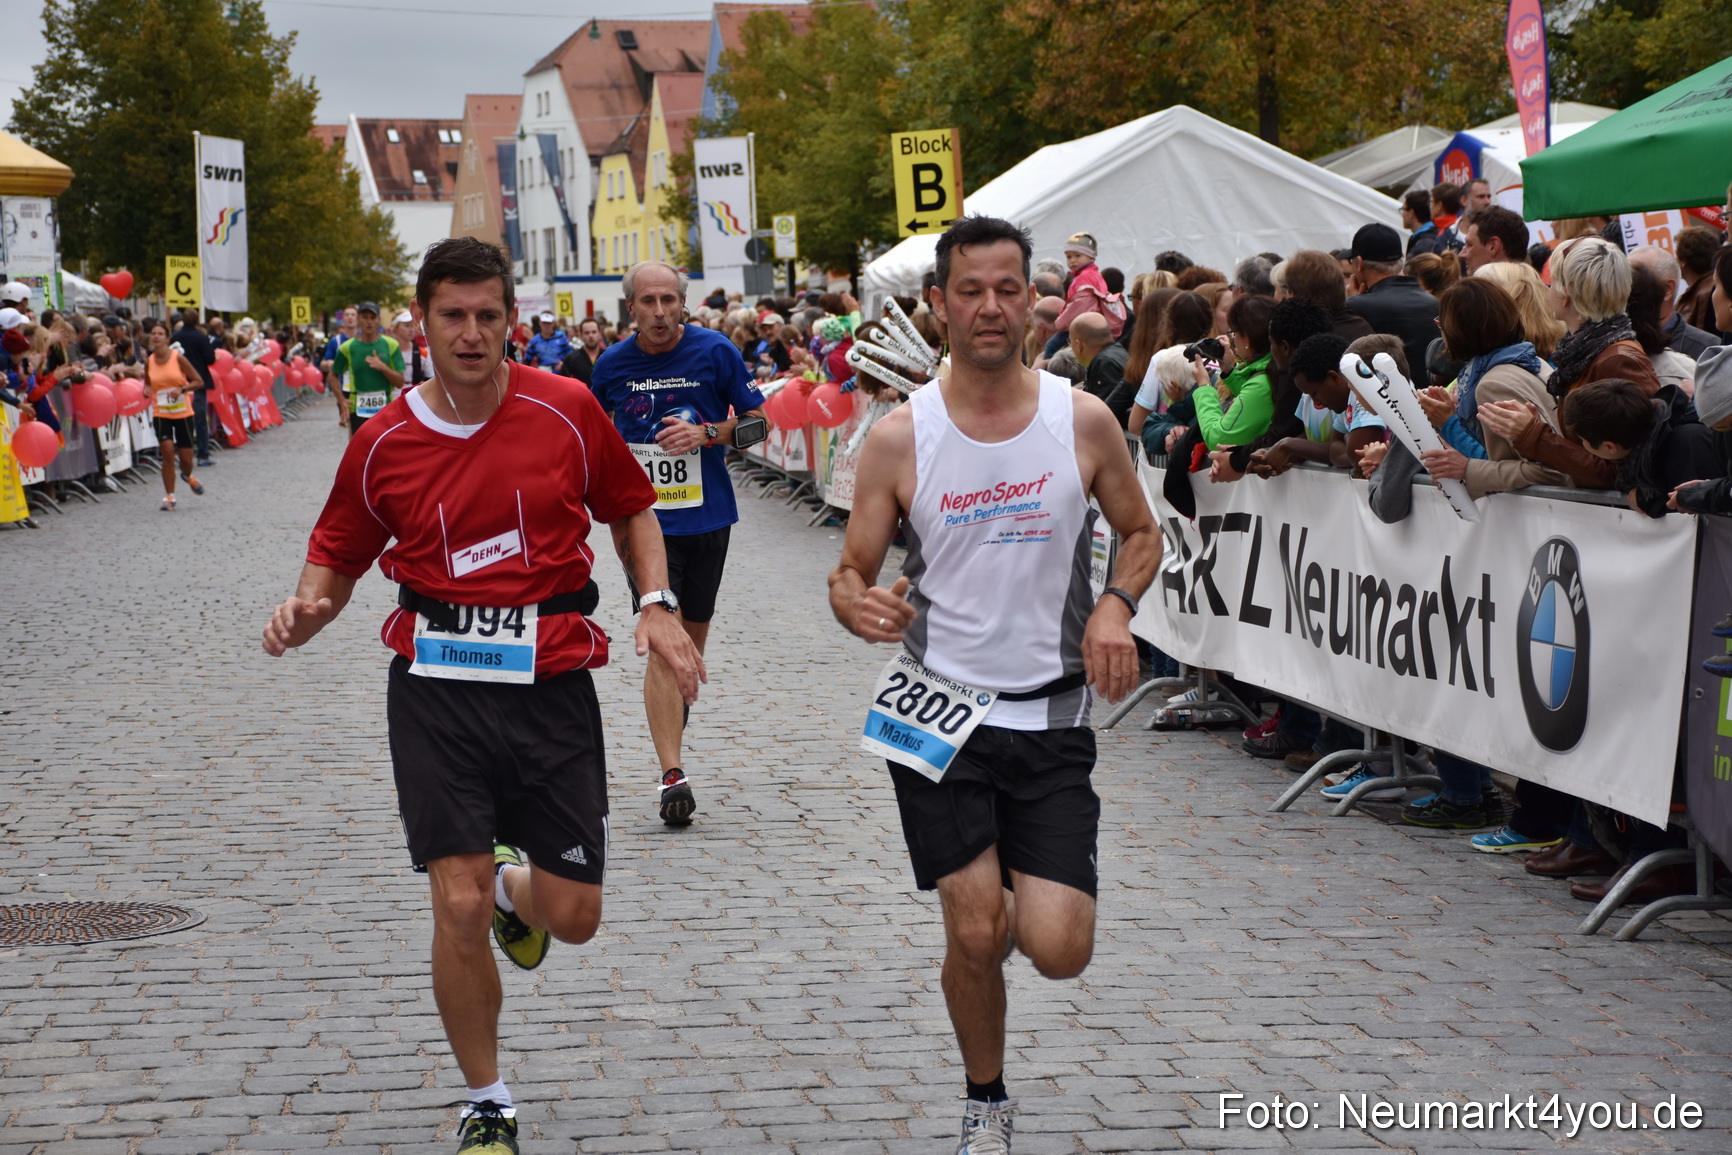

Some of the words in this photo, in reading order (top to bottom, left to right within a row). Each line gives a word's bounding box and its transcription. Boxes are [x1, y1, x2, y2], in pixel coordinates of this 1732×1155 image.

[900, 134, 953, 156] Block
[203, 164, 243, 183] swn
[911, 163, 947, 213] B
[169, 258, 197, 269] Block
[174, 271, 192, 297] C
[296, 305, 307, 319] D
[560, 299, 570, 313] D
[631, 378, 660, 392] hella
[659, 381, 701, 389] halbmarathon
[944, 514, 970, 527] Pure
[973, 501, 1042, 521] Performance
[471, 542, 502, 564] DEHN
[1528, 543, 1585, 616] BMW
[1160, 512, 1272, 629] ARTL
[1279, 523, 1496, 699] Neumarkt
[440, 645, 503, 665] Thomas
[921, 667, 974, 699] Neumarkt
[875, 671, 973, 735] 2800
[878, 721, 924, 752] Markus
[561, 852, 588, 865] adidas
